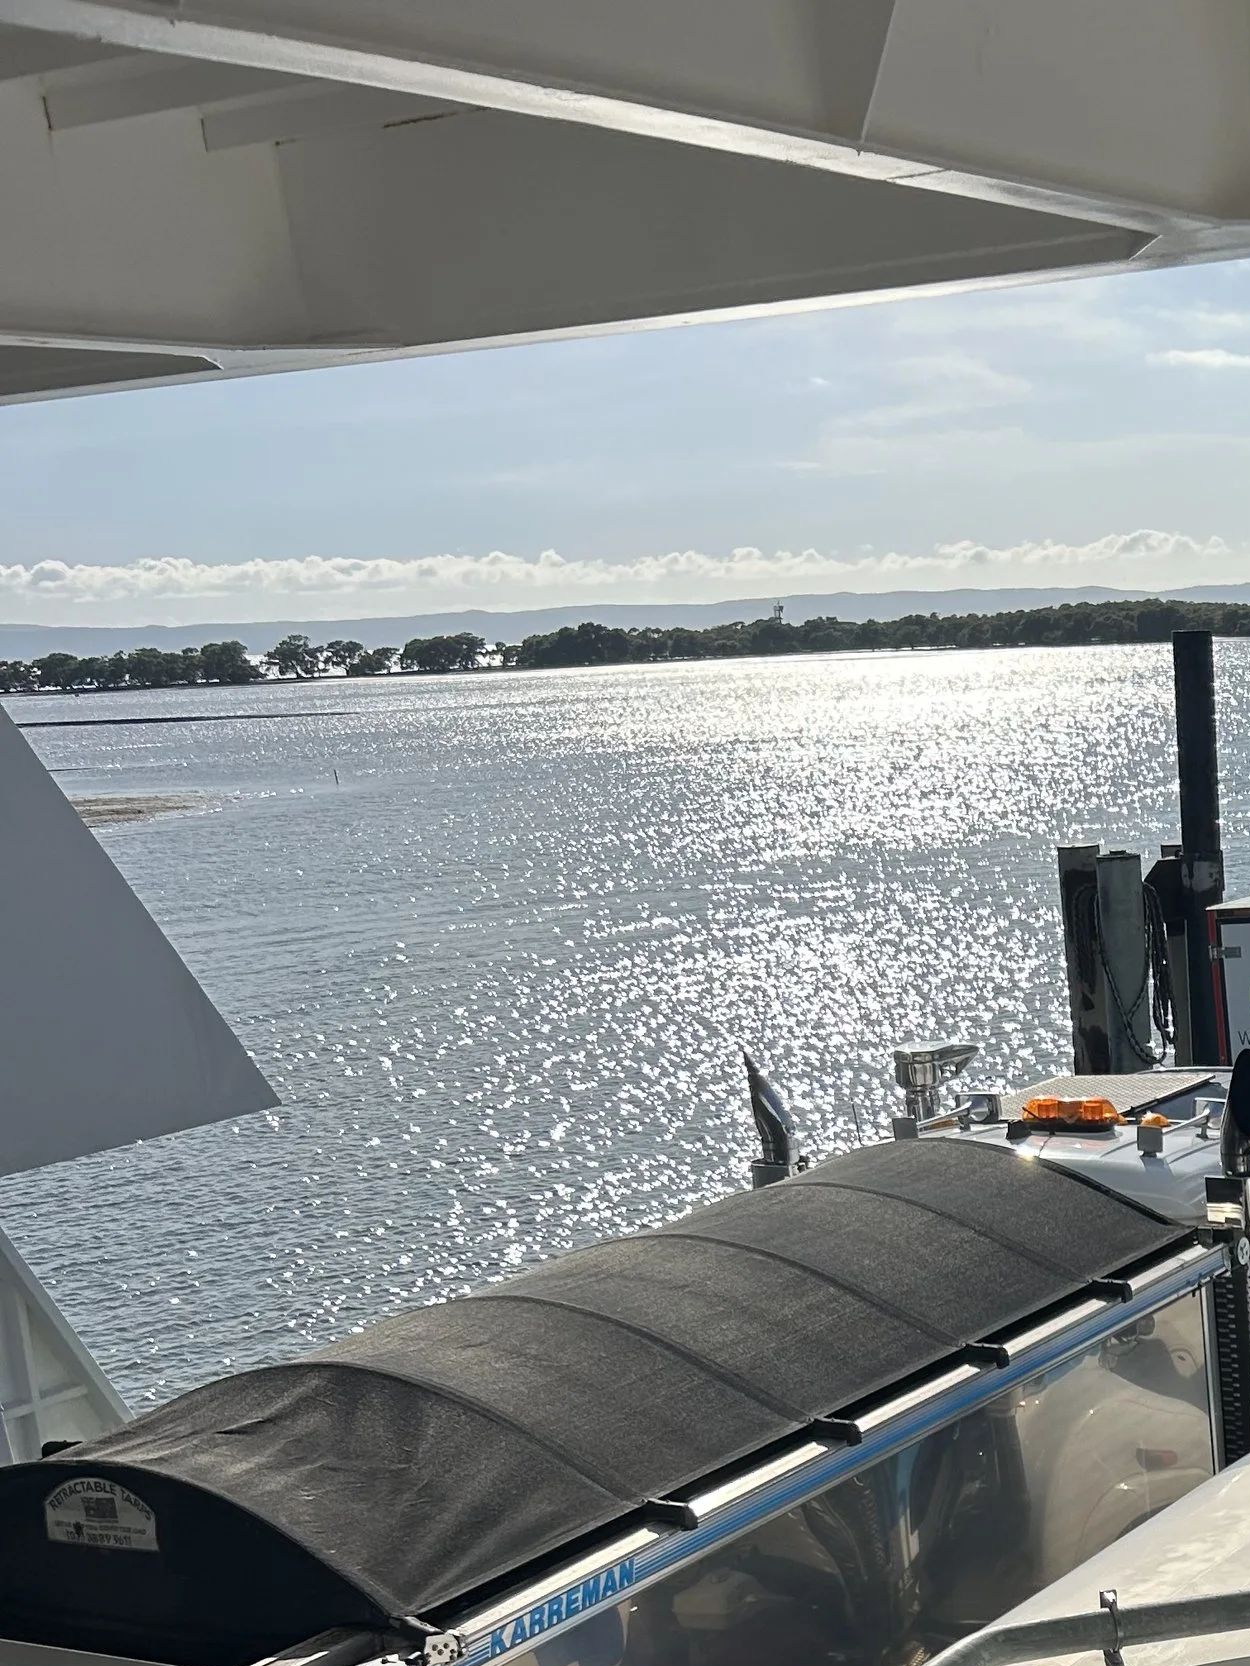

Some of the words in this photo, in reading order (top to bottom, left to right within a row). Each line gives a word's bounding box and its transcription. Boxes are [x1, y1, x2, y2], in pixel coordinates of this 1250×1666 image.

[48, 1480, 117, 1511] RETRACTABLE
[120, 1488, 153, 1521] TARPS
[489, 1557, 635, 1657] KARREMAN
